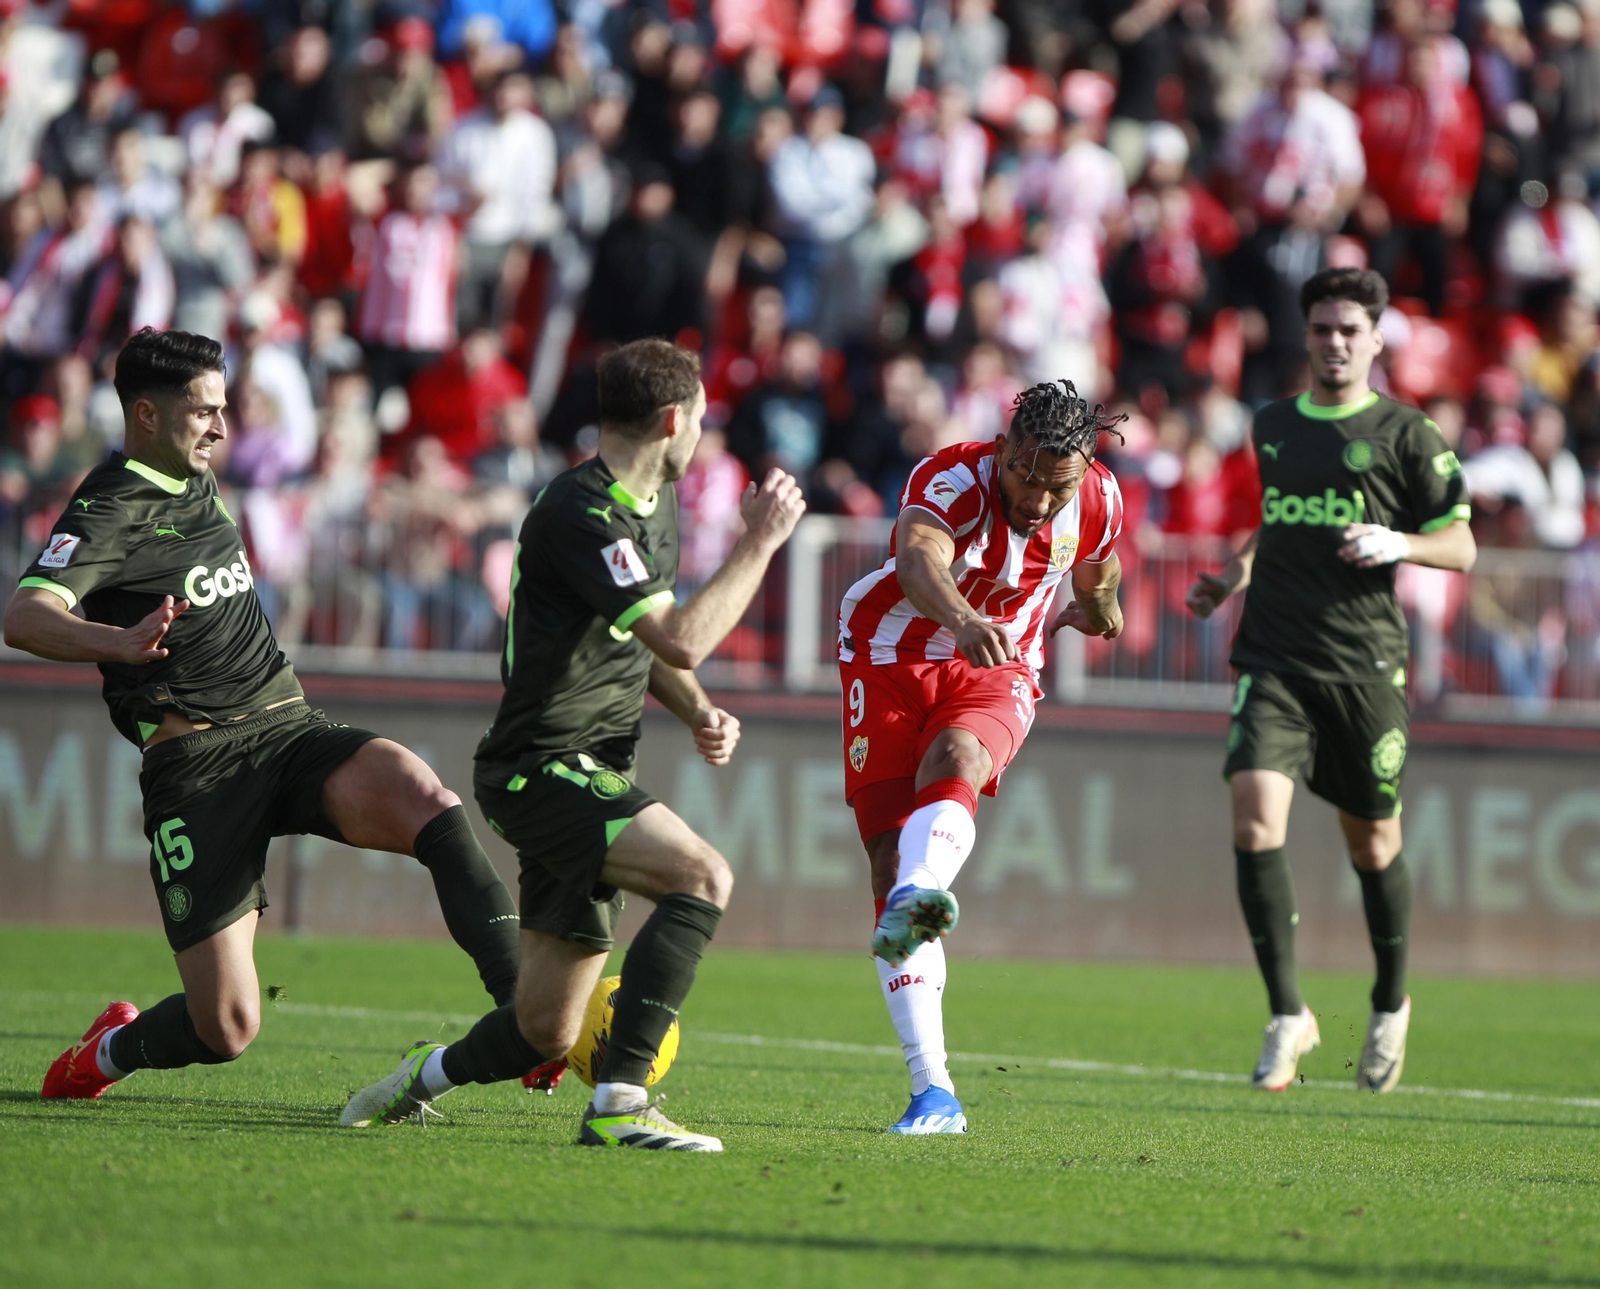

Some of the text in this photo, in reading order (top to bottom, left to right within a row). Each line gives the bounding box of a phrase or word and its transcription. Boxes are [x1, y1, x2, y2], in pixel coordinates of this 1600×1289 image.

[1263, 486, 1365, 527] Gosbi
[849, 678, 865, 728] 9
[153, 817, 194, 883] 15
[488, 914, 520, 923] GIRON
[888, 974, 926, 993] UDA
